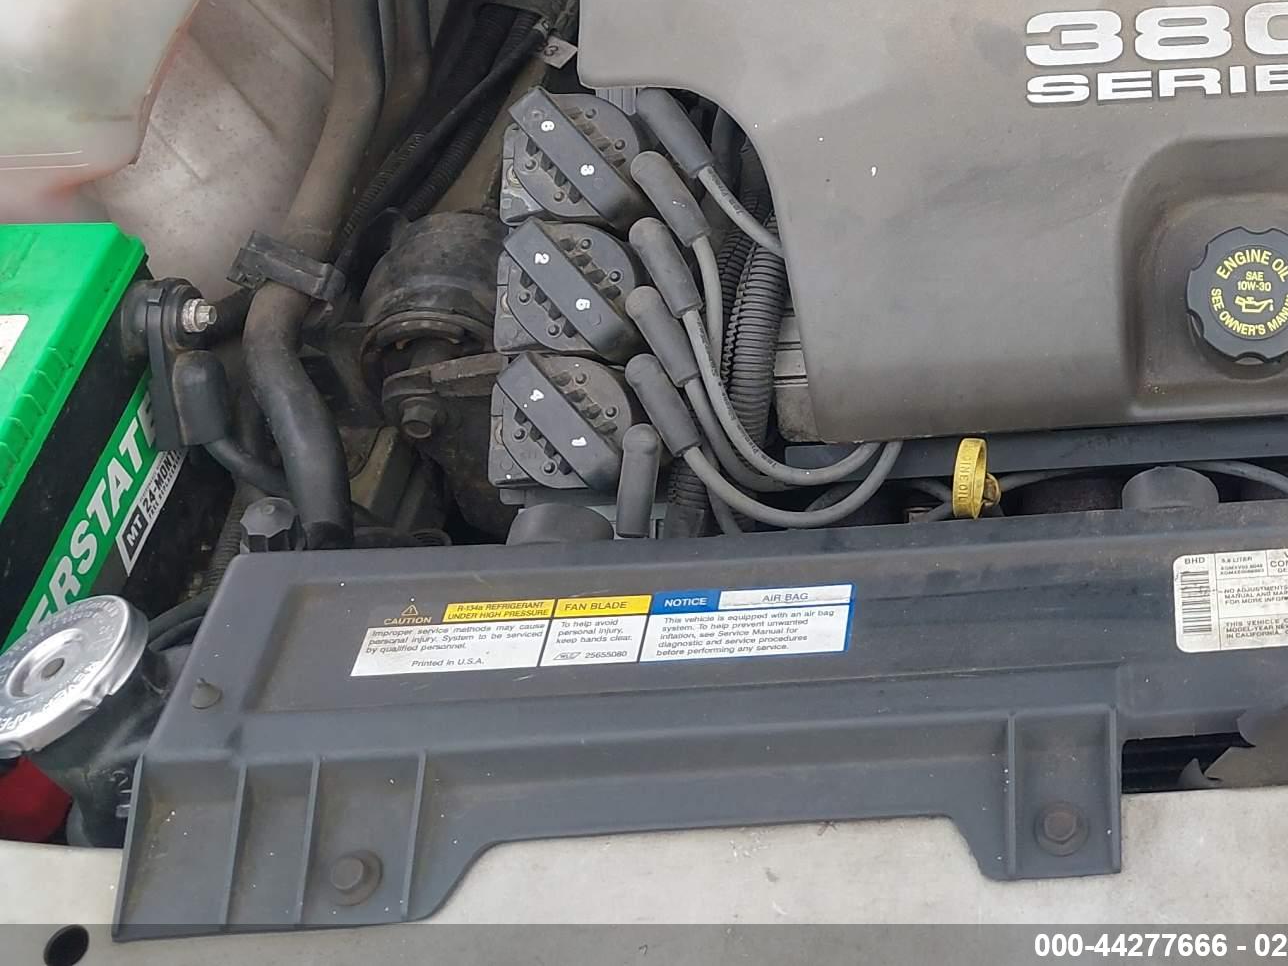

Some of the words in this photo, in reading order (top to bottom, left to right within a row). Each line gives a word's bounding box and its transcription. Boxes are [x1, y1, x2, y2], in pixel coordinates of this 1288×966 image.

[541, 120, 555, 132] 6
[580, 164, 595, 176] 3
[534, 253, 549, 265] 2
[1216, 249, 1272, 280] ENGINE
[1246, 271, 1264, 281] SAE
[1238, 281, 1271, 291] 10W-30
[575, 299, 591, 311] 5
[1211, 288, 1225, 311] SEE
[1219, 310, 1266, 336] OWNER'S
[530, 389, 545, 402] 4
[126, 514, 143, 547] MT
[1236, 585, 1288, 593] ADJUSTMENTS
[664, 598, 707, 607] NOTICE
[762, 594, 782, 602] AIR
[785, 593, 808, 601] BAG
[456, 604, 484, 612] R-134a
[486, 602, 544, 610] REFRIGERANT
[590, 602, 628, 610] BLADE
[448, 611, 478, 620] UNDER
[503, 609, 549, 617] PRESSURE
[727, 614, 768, 622] equipped
[818, 609, 834, 617] bag
[384, 617, 432, 625] CAUTION
[595, 618, 618, 626] avoid
[710, 622, 729, 630] help
[732, 621, 765, 629] prevent
[1247, 618, 1279, 626] VEHICLE
[372, 629, 413, 638] Improper
[417, 627, 448, 635] service
[558, 628, 597, 637] personal
[368, 637, 408, 646] personal
[411, 636, 438, 644] injury.
[442, 634, 474, 642] System
[658, 640, 702, 648] diagnostic
[759, 635, 808, 643] procedures
[365, 646, 377, 655] by
[379, 644, 418, 653] qualified
[421, 643, 466, 652] personnel.
[656, 648, 685, 656] before
[687, 646, 735, 655] performing
